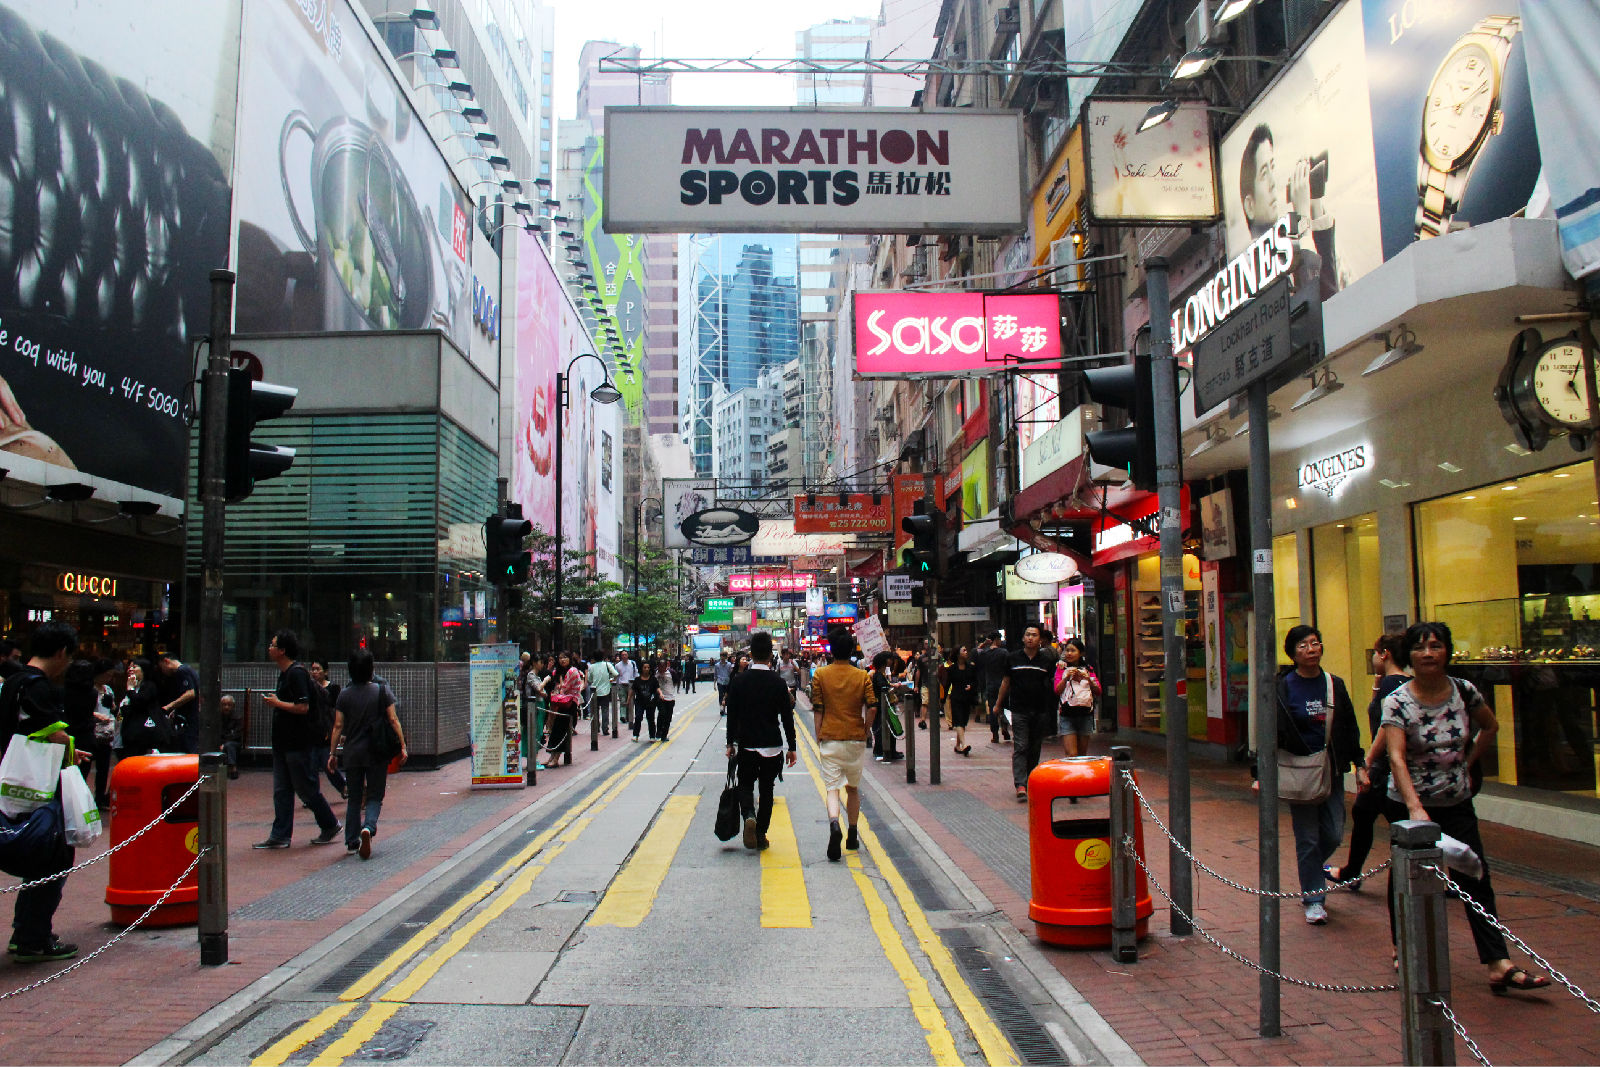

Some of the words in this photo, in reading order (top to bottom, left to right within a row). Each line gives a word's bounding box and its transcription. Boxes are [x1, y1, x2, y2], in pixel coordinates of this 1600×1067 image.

[680, 127, 949, 165] MARATHON
[680, 169, 860, 206] SPORTS
[865, 171, 951, 196] 馬拉松
[1148, 163, 1183, 178] Nail
[1172, 216, 1294, 355] LONGINES
[473, 275, 500, 340] SOGO
[1220, 314, 1258, 353] Lockhart
[1260, 291, 1286, 325] Road
[992, 314, 1048, 353] 莎莎
[1563, 348, 1573, 356] 12
[15, 335, 41, 367] coq
[47, 349, 77, 377] with
[122, 377, 144, 402] 4/F
[148, 387, 179, 417] SOGO
[1536, 380, 1543, 388] 9
[1297, 446, 1366, 488] LONGINES
[759, 520, 806, 541] Persn
[838, 520, 849, 528] 25
[851, 519, 868, 528] 722
[869, 518, 887, 528] 900
[64, 572, 117, 597] GUCCI
